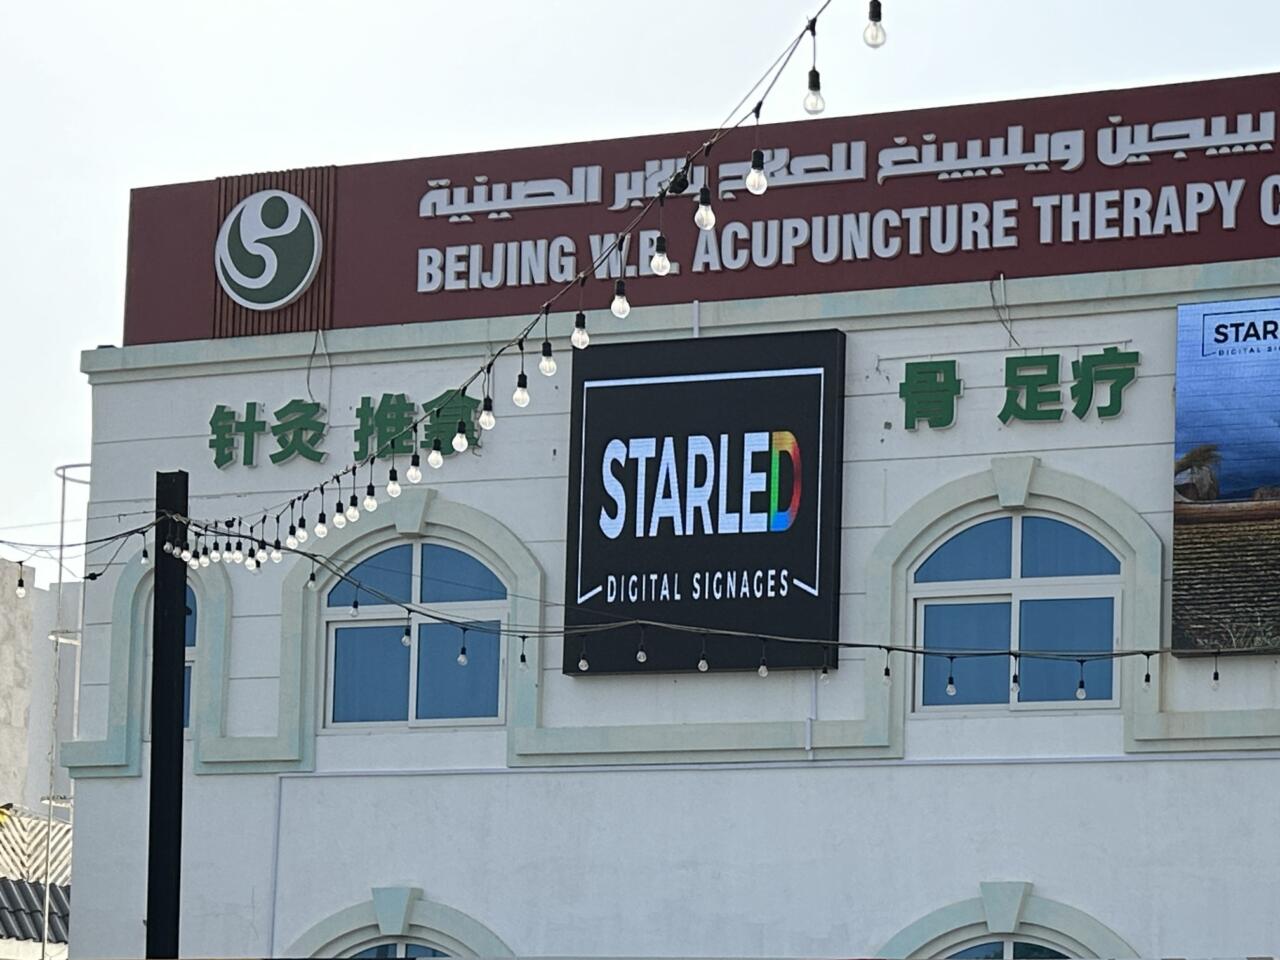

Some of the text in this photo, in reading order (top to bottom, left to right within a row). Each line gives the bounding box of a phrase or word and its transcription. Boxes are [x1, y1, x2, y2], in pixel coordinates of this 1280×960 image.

[419, 165, 603, 223] الصينية
[417, 236, 577, 293] BEIJING
[691, 199, 1019, 272] ACUPUNCTURE
[1032, 178, 1246, 245] THERAPY
[1218, 346, 1262, 357] DIGITAL
[899, 346, 1141, 432] 骨 足疗
[209, 399, 330, 470] 针灸
[599, 430, 802, 539] STARLED
[607, 569, 789, 603] DIGITAL SIGNAGES
